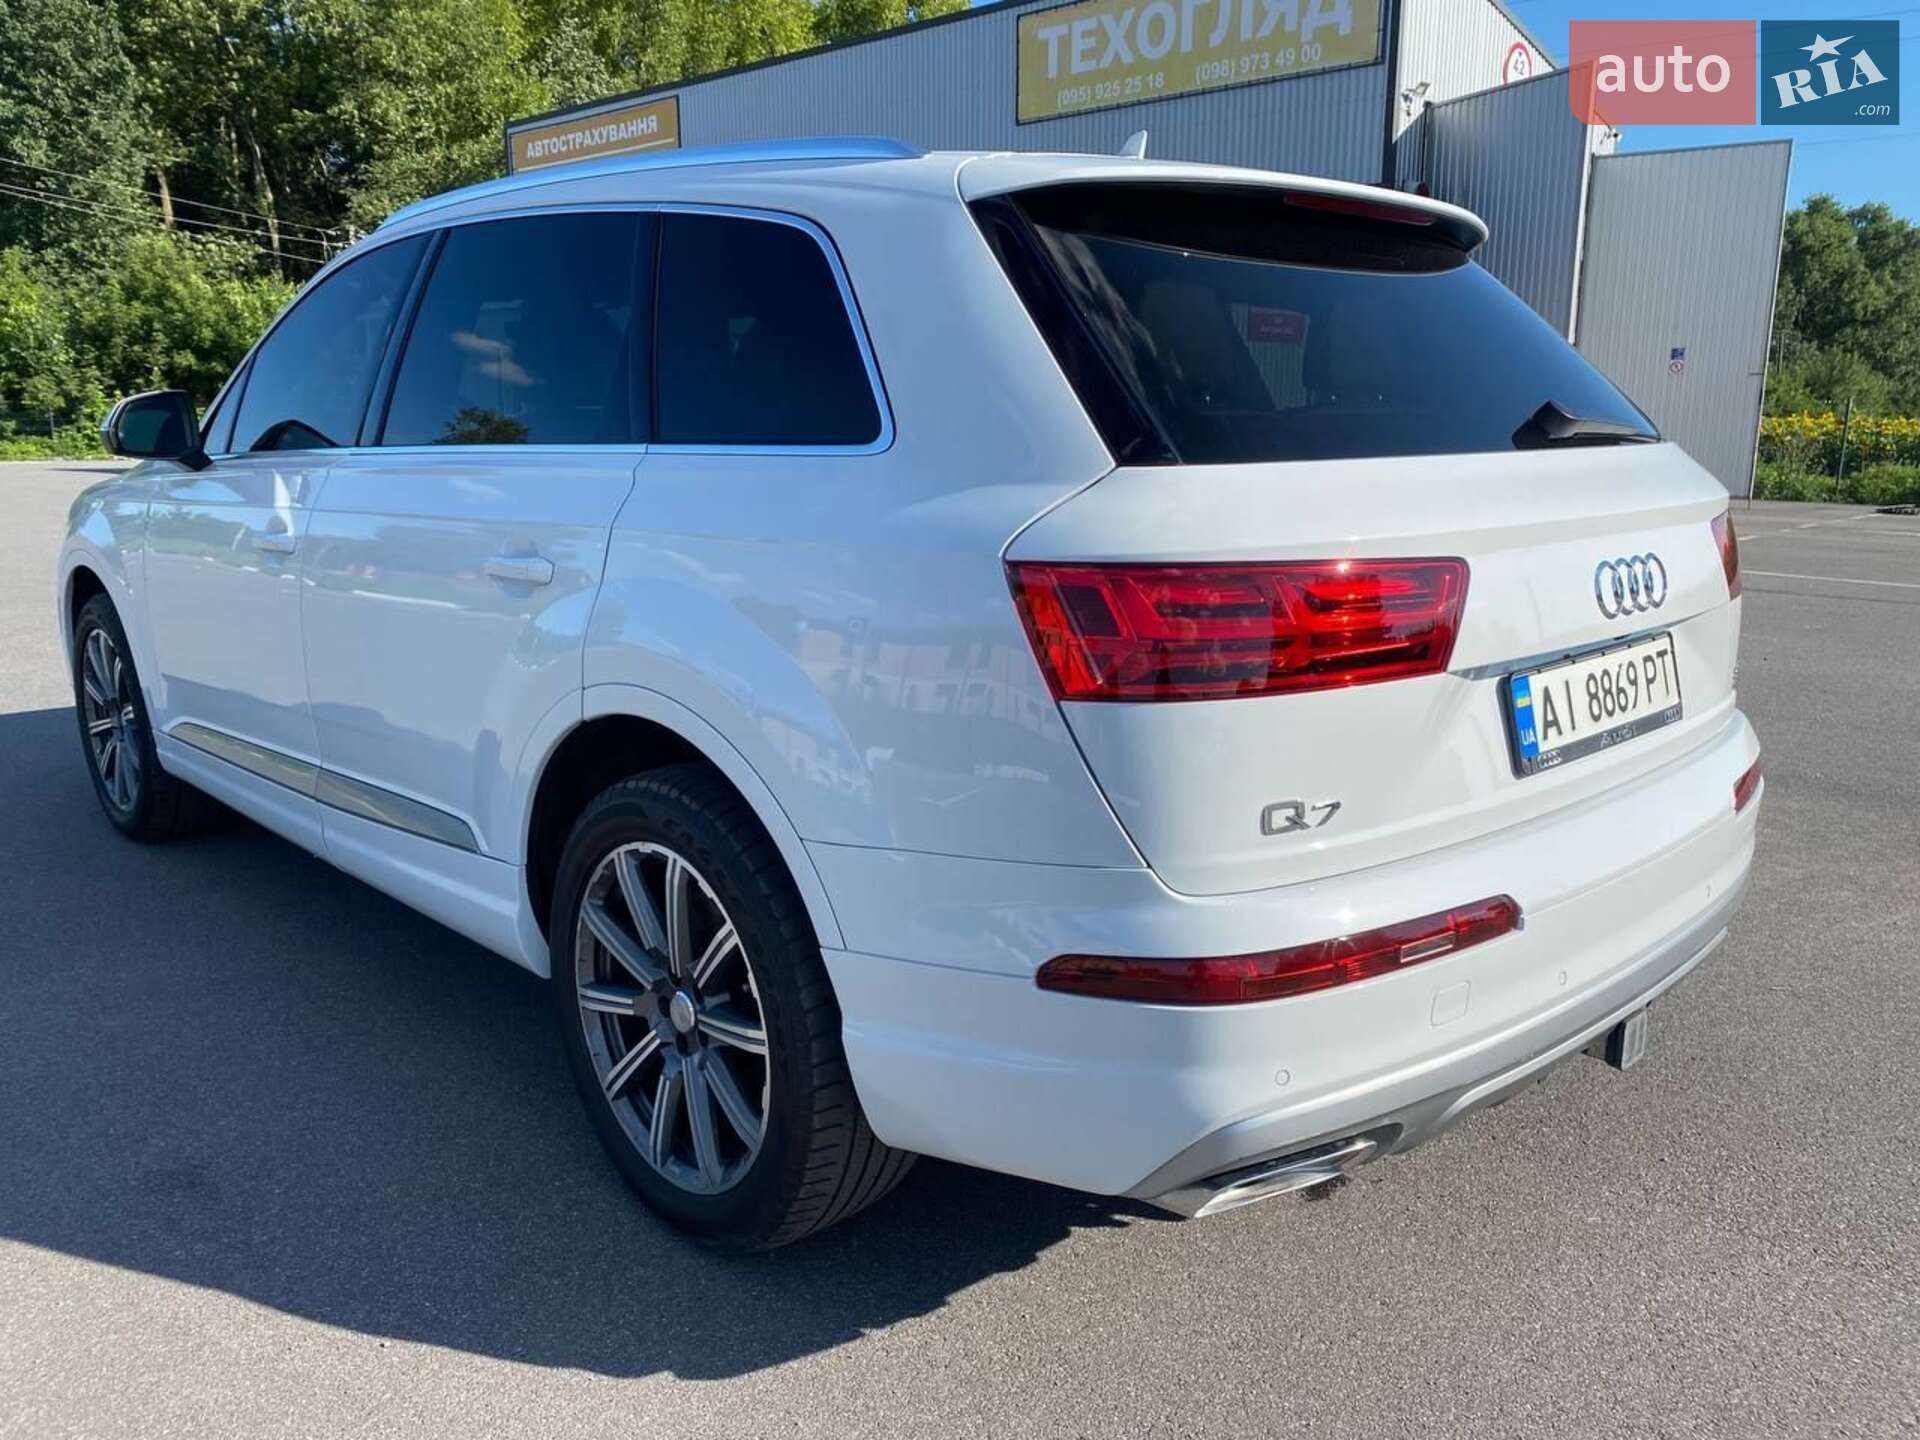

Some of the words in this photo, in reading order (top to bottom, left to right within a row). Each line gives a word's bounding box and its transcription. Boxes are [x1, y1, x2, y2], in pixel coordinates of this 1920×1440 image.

[1038, 0, 1353, 79] ТЕХОГЛЯД
[527, 114, 658, 158] АВТОСТРАХУВАННЯ
[1542, 679, 1576, 741] AI
[1586, 660, 1639, 723] 8869
[1643, 648, 1671, 704] PT
[1520, 729, 1537, 745] UA
[1260, 800, 1342, 836] Q7
